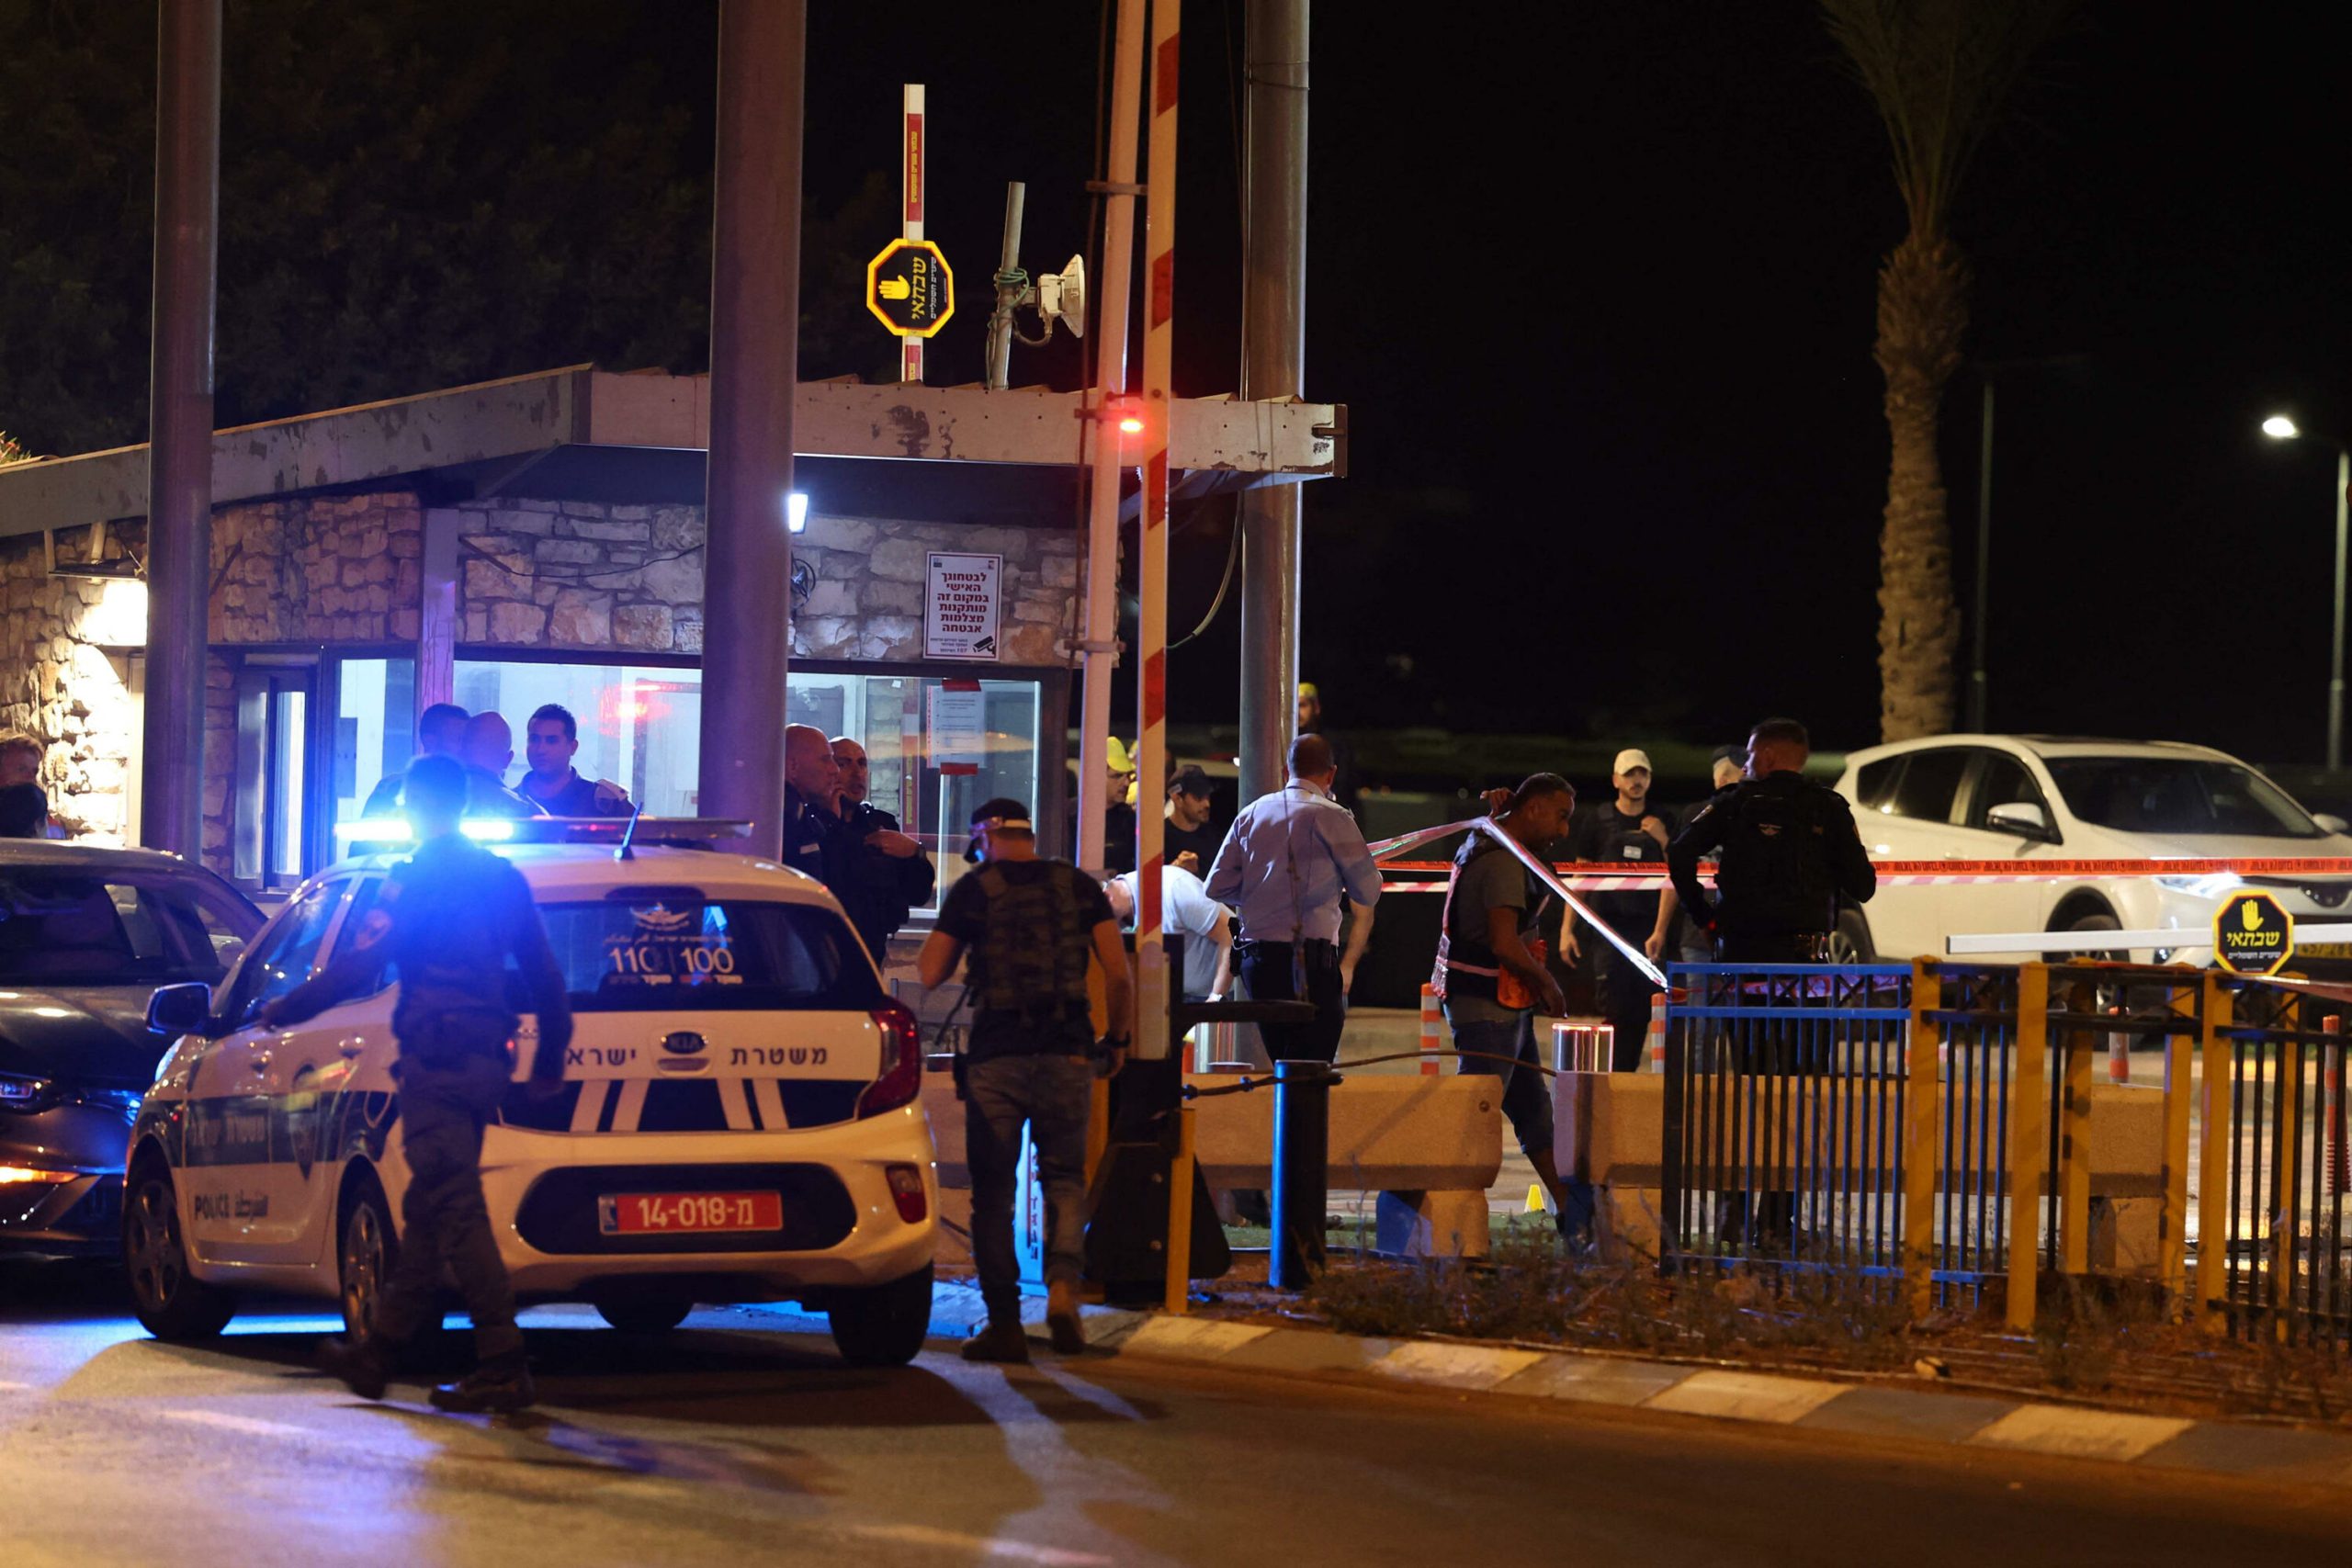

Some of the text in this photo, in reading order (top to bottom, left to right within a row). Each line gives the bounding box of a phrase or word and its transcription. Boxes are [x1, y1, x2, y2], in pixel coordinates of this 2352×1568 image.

[911, 256, 926, 320] שבתאי
[941, 572, 987, 582] לבטחונך
[946, 583, 981, 592] האישי
[937, 592, 989, 604] במקום זה
[939, 603, 988, 614] מותקנות
[940, 613, 985, 623] מצלמות
[942, 624, 982, 633] אבטחה
[2226, 931, 2280, 947] שבתאי
[680, 947, 734, 974] 100
[566, 1047, 828, 1066] משטרת ישרא
